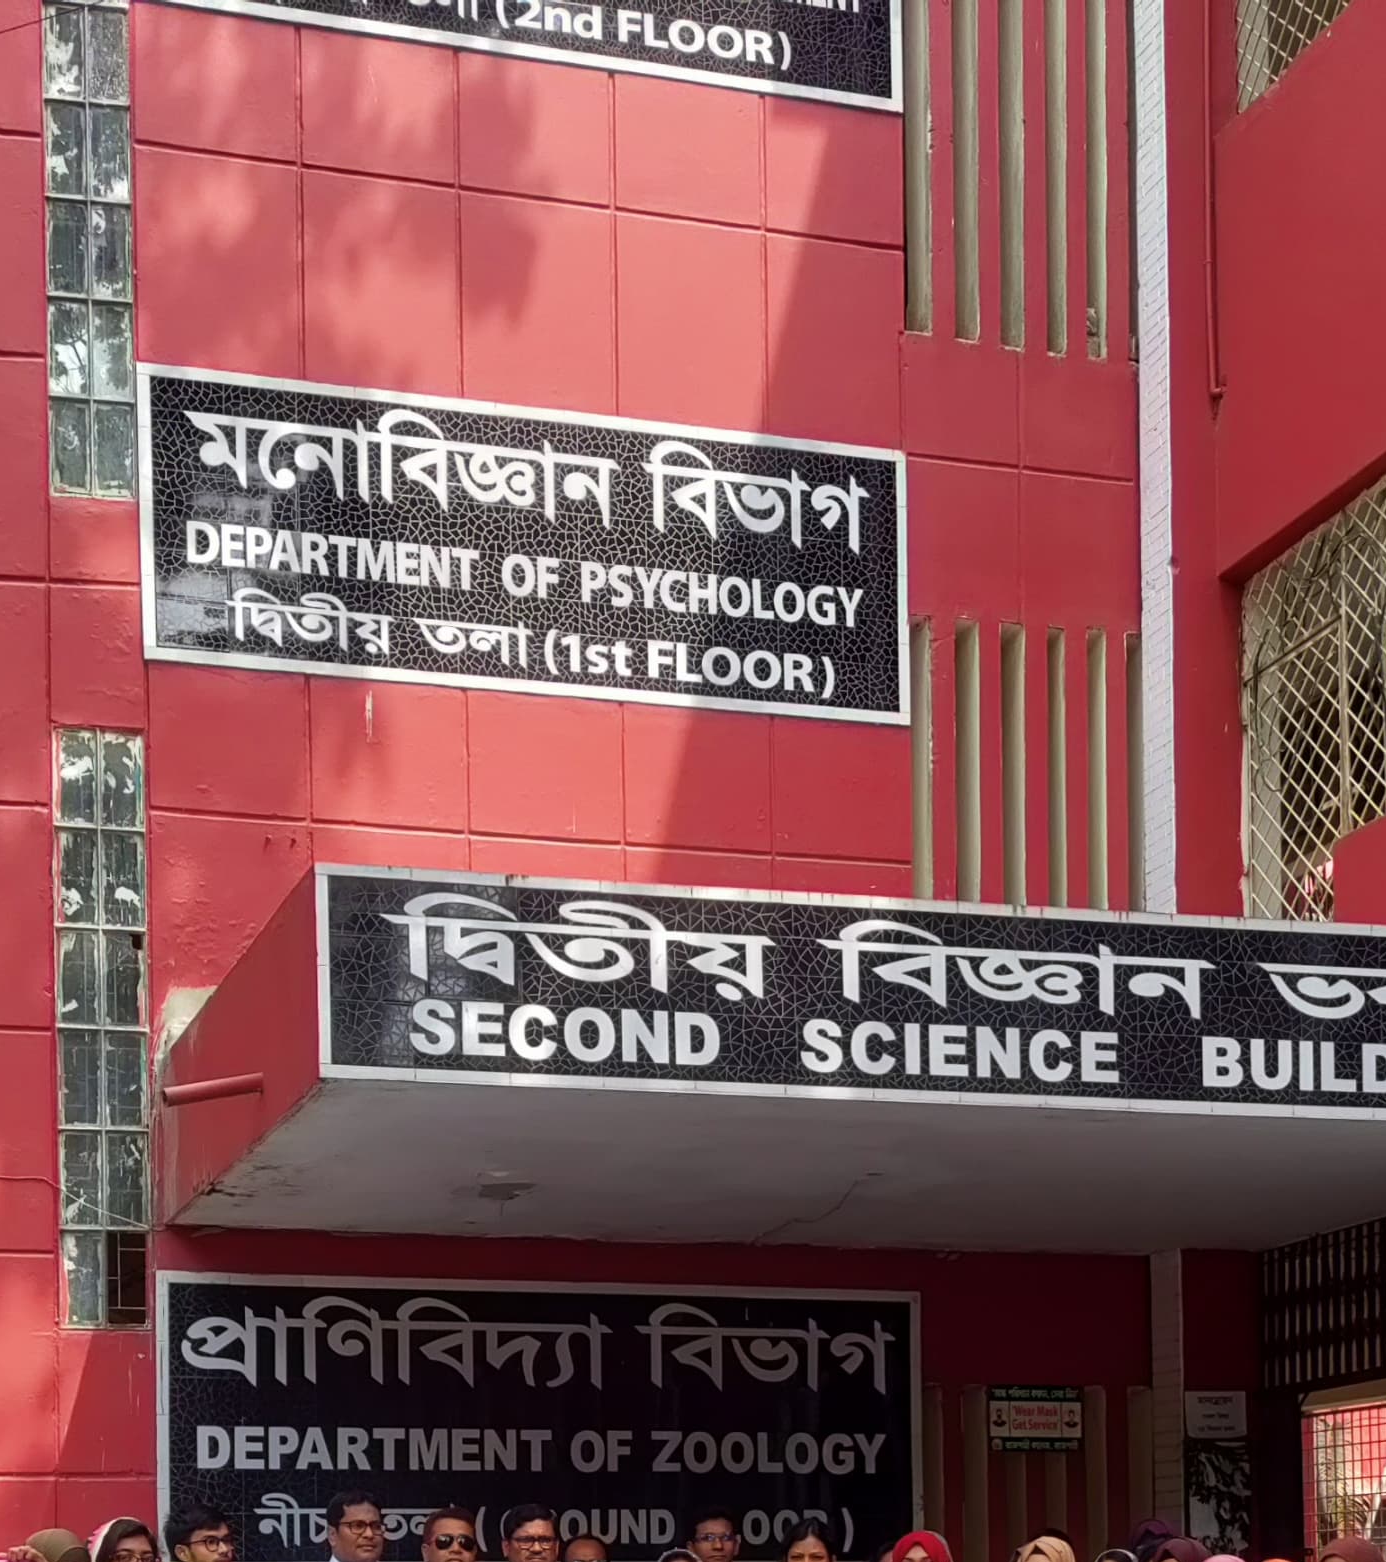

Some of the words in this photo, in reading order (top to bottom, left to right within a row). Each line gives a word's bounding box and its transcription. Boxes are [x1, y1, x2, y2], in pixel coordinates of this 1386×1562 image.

[618, 12, 793, 71] FLOOR)
[183, 408, 621, 529] মনোবিজ্ঞান
[642, 440, 871, 555] বিভাগ
[186, 519, 481, 591] DEPARTMENT
[501, 554, 561, 600] OF
[580, 560, 865, 628] PSYCHOLOGY
[225, 587, 394, 656] দ্বিতীয়
[412, 615, 534, 669] তলা
[544, 628, 633, 679] (1st
[647, 639, 838, 700] FLOOR)
[380, 890, 779, 1001] দ্বিতীয়
[820, 919, 1217, 1021] বিজ্ঞান
[412, 1000, 722, 1068] SECOND
[800, 1018, 1122, 1086] SCIENCE
[180, 1295, 613, 1390] প্রাণিবিদ্যা
[635, 1302, 897, 1396] বিভাগ
[195, 1424, 553, 1473] DEPARTMENT
[570, 1429, 635, 1473] OF
[652, 1431, 888, 1476] ZOOLOGY
[500, 1507, 676, 1546] OUND
